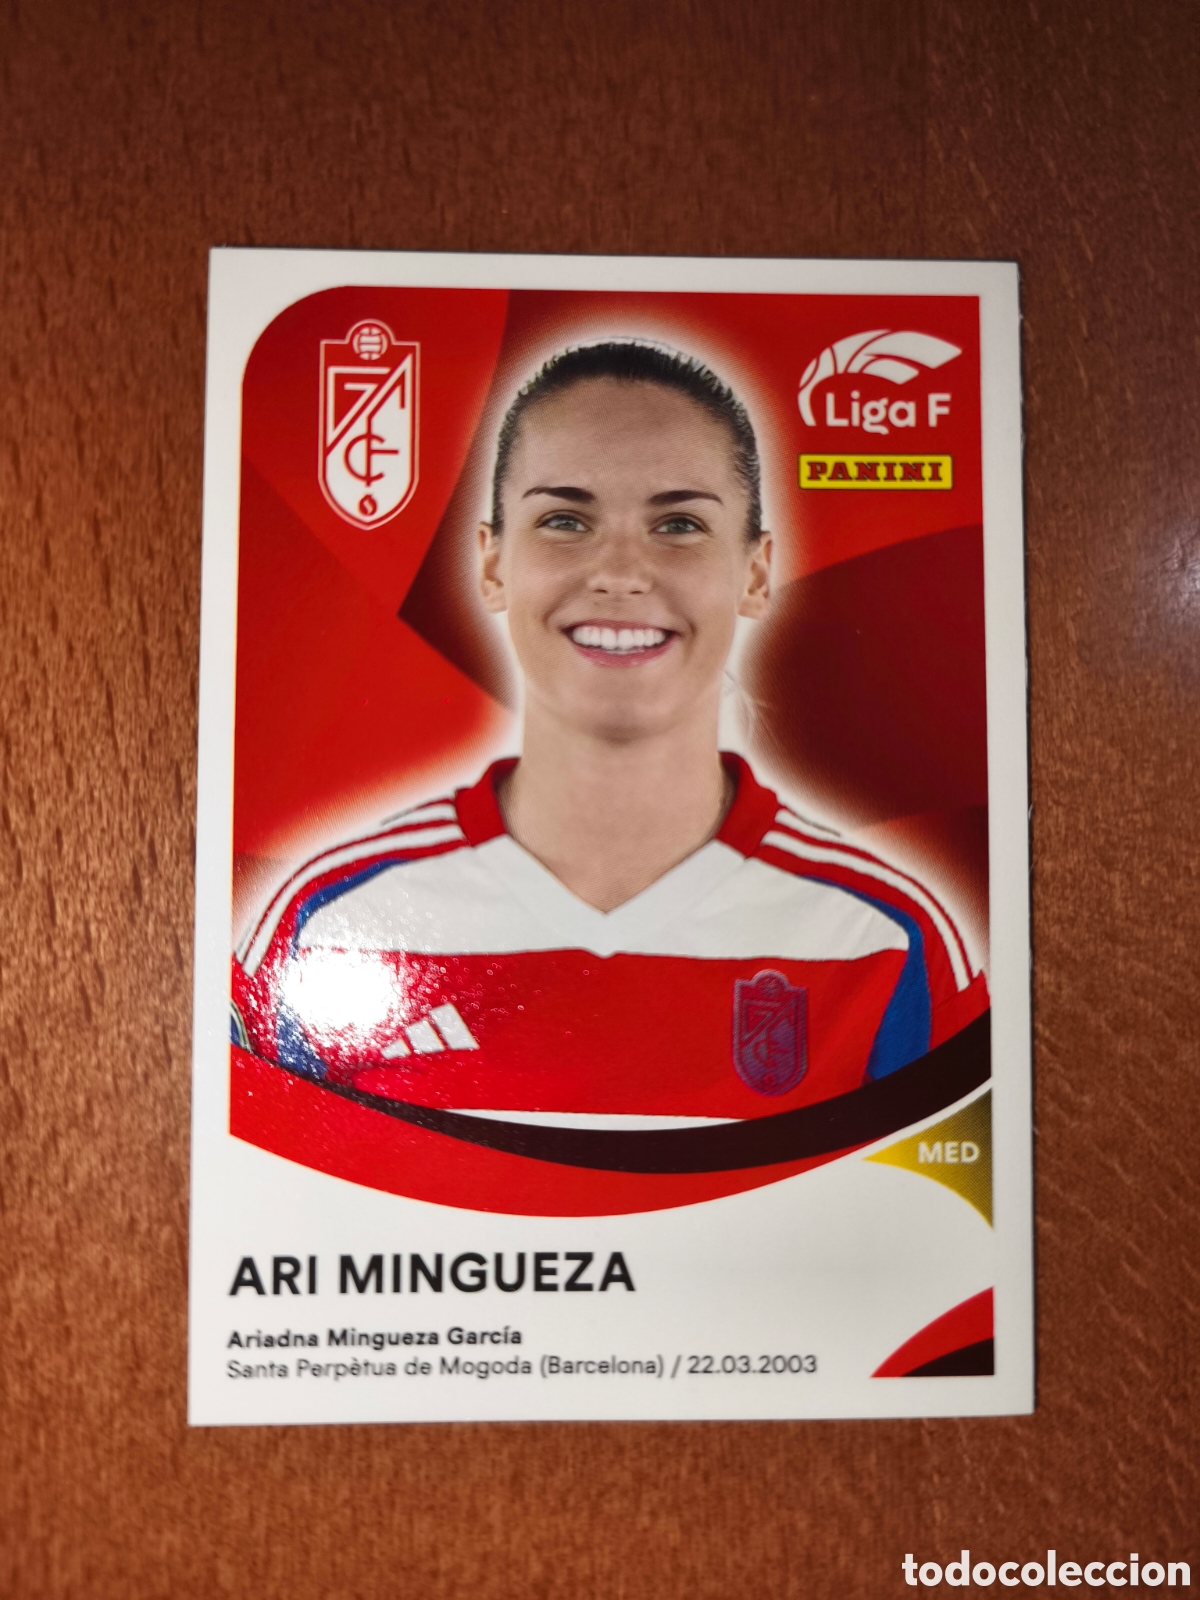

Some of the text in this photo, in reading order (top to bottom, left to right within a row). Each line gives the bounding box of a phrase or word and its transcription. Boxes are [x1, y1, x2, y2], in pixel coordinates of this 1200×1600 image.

[826, 390, 952, 435] Liga F
[806, 460, 944, 483] PANINI
[917, 1140, 981, 1165] MED
[229, 1251, 636, 1297] ARI MINGUEZA
[227, 1325, 523, 1351] Ariadna Mingueza García
[226, 1354, 818, 1382] Santa Perpètua de Mogoda (Barcelona) / 22.03.2003
